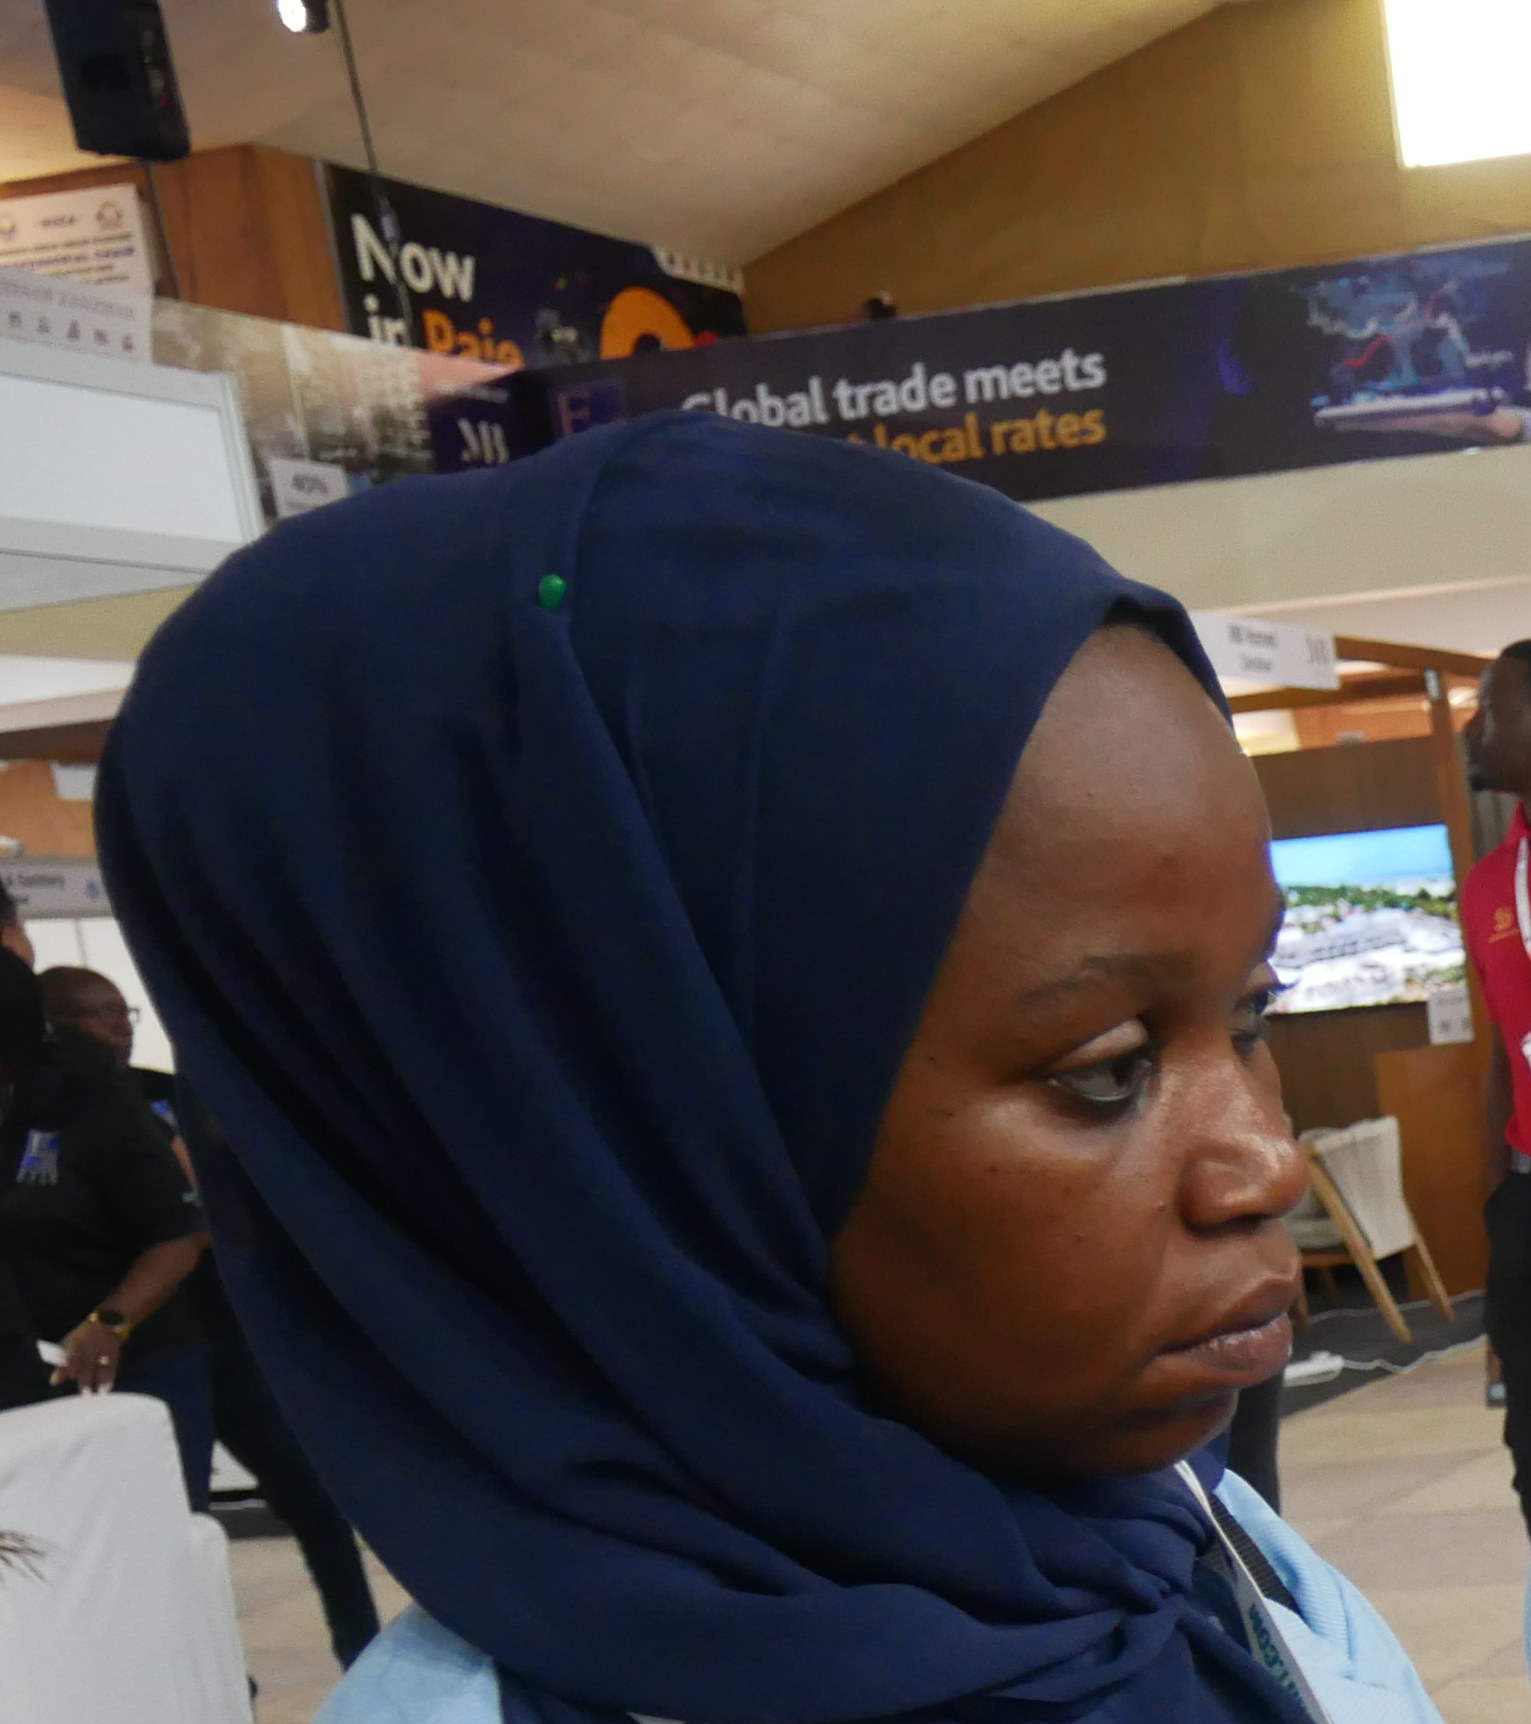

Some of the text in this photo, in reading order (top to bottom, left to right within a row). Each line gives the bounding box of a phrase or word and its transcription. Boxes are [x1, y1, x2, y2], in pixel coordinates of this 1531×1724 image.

[351, 213, 476, 302] Now
[834, 364, 956, 418] trade
[965, 347, 1106, 400] meets
[991, 408, 1106, 453] rates
